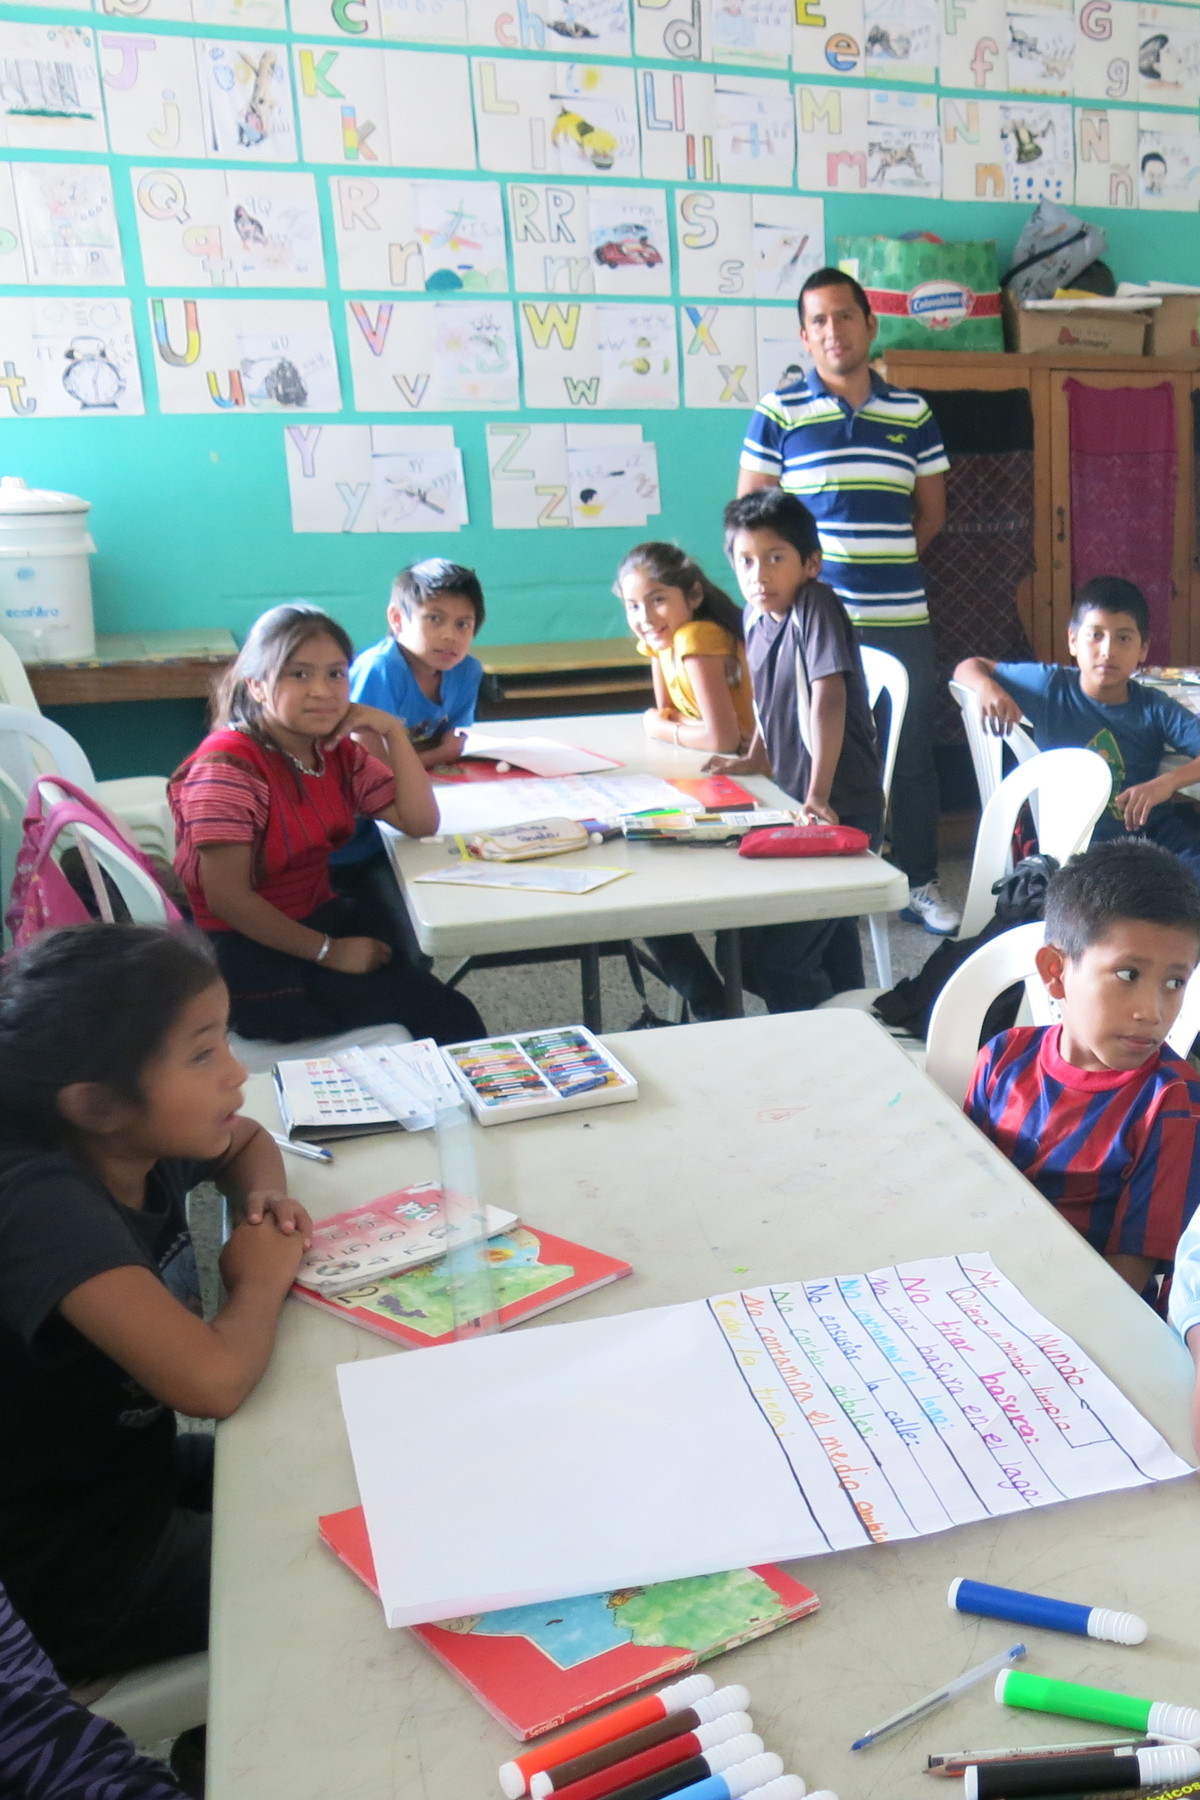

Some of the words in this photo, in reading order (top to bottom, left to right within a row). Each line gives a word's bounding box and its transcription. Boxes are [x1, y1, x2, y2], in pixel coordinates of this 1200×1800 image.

[742, 1294, 766, 1317] No
[770, 1291, 794, 1313] No
[806, 1284, 832, 1304] No
[865, 1377, 891, 1392] la
[840, 1279, 862, 1299] No
[900, 1370, 927, 1383] el
[870, 1277, 891, 1295] No
[886, 1306, 918, 1330] tirar
[917, 1343, 964, 1395] basura
[900, 1278, 930, 1304] No
[934, 1320, 975, 1352] tirar
